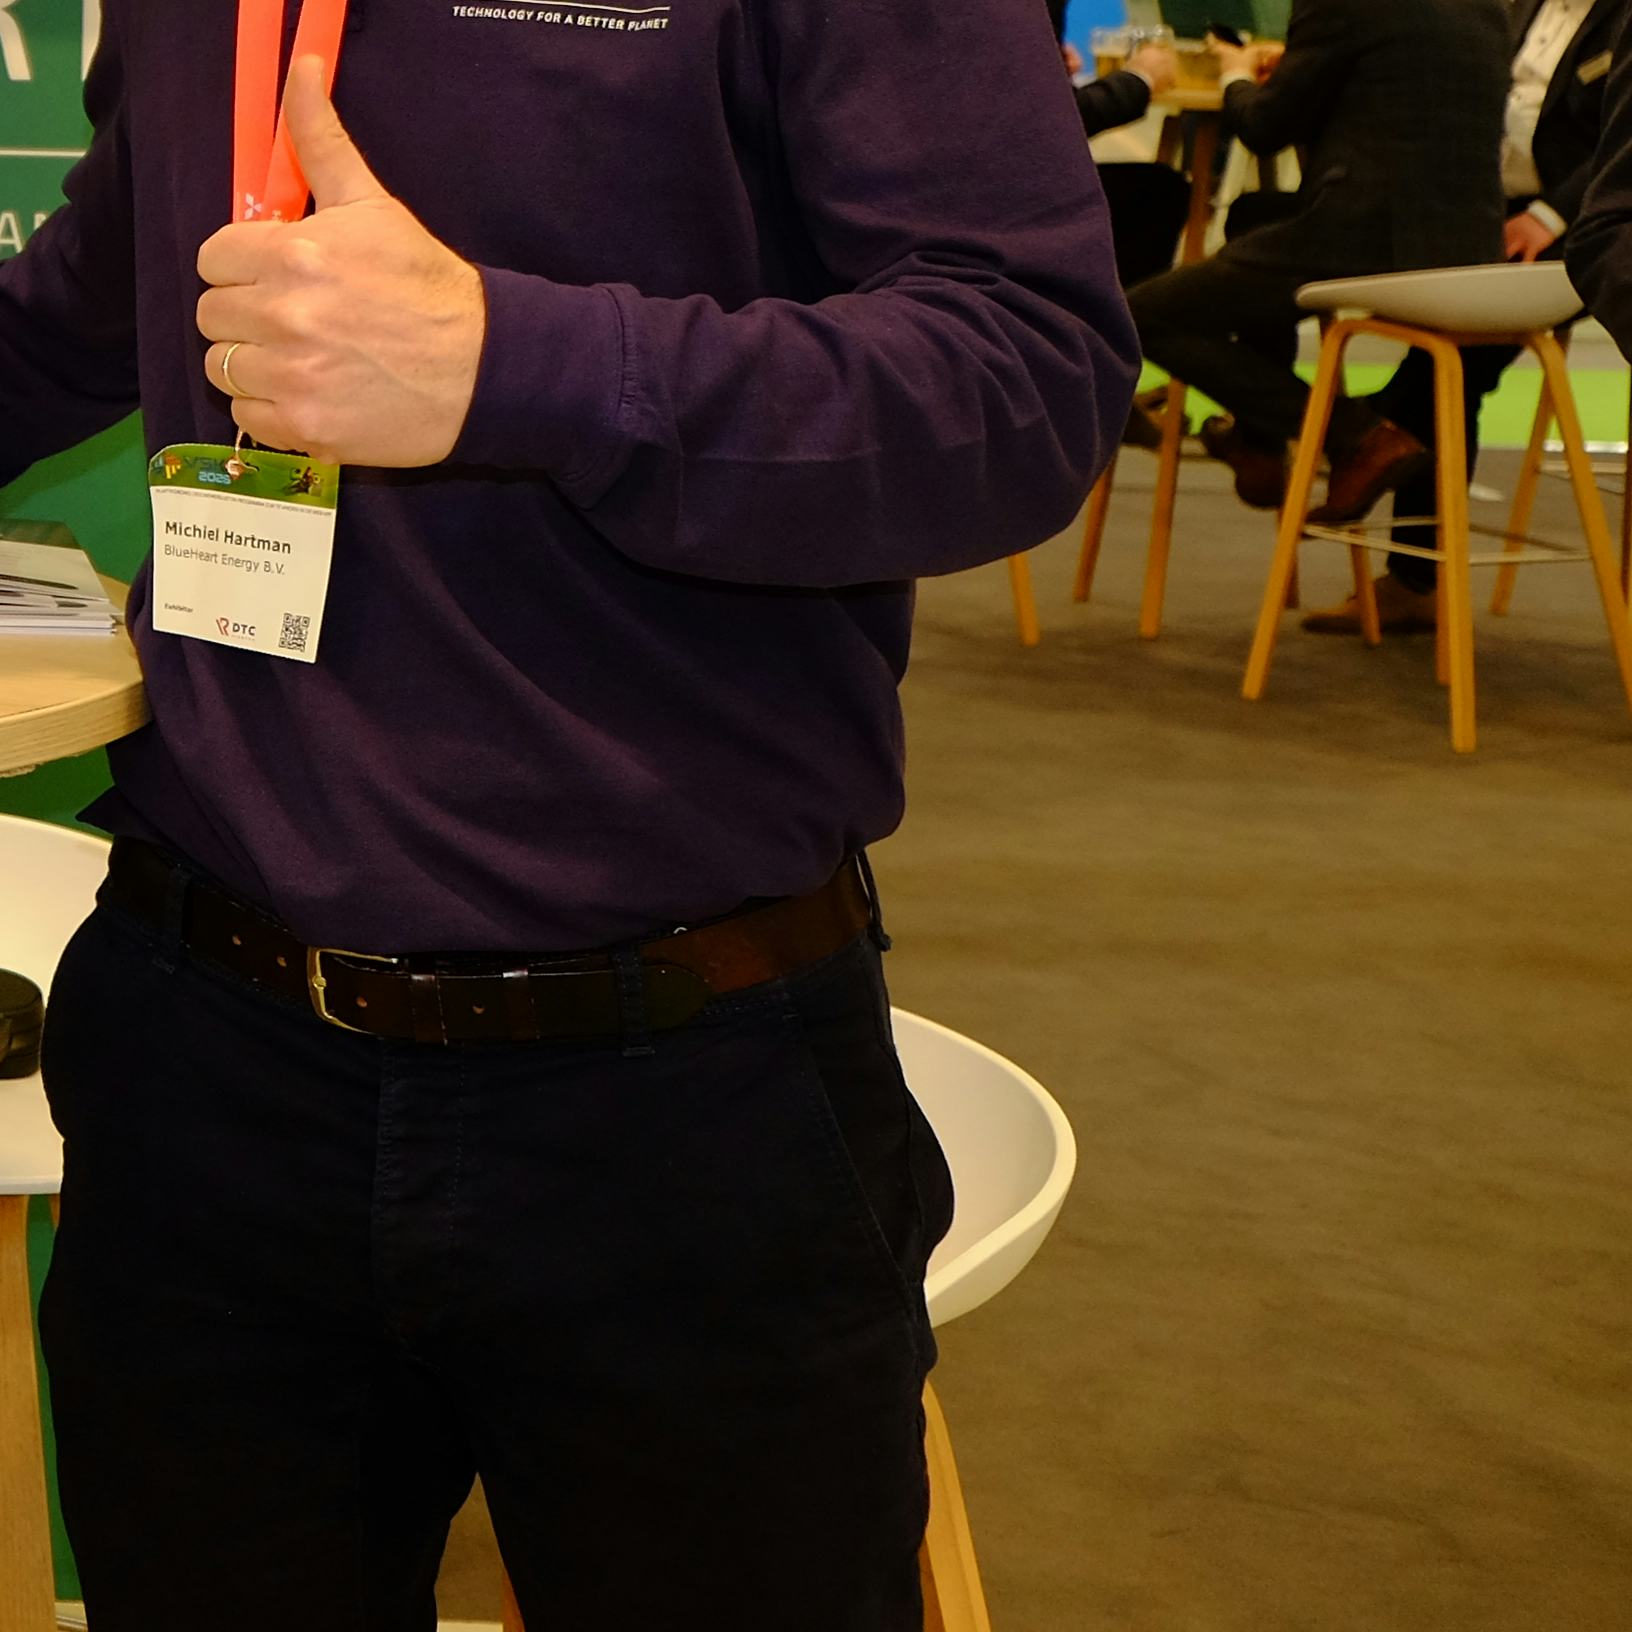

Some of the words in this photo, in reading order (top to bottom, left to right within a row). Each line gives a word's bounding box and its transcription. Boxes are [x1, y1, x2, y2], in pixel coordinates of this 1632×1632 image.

[452, 5, 534, 21] TECHNOLOGY
[537, 10, 561, 24] FOR
[564, 14, 574, 25] A
[577, 15, 624, 30] BETTER
[628, 18, 669, 32] PLANET
[198, 470, 232, 485] 2025
[165, 520, 219, 542] Michiel
[224, 530, 292, 555] Hartman
[164, 543, 218, 564] BlueHeart
[221, 553, 260, 573] Energy
[264, 560, 285, 575] B.V.
[232, 621, 256, 637] DTC
